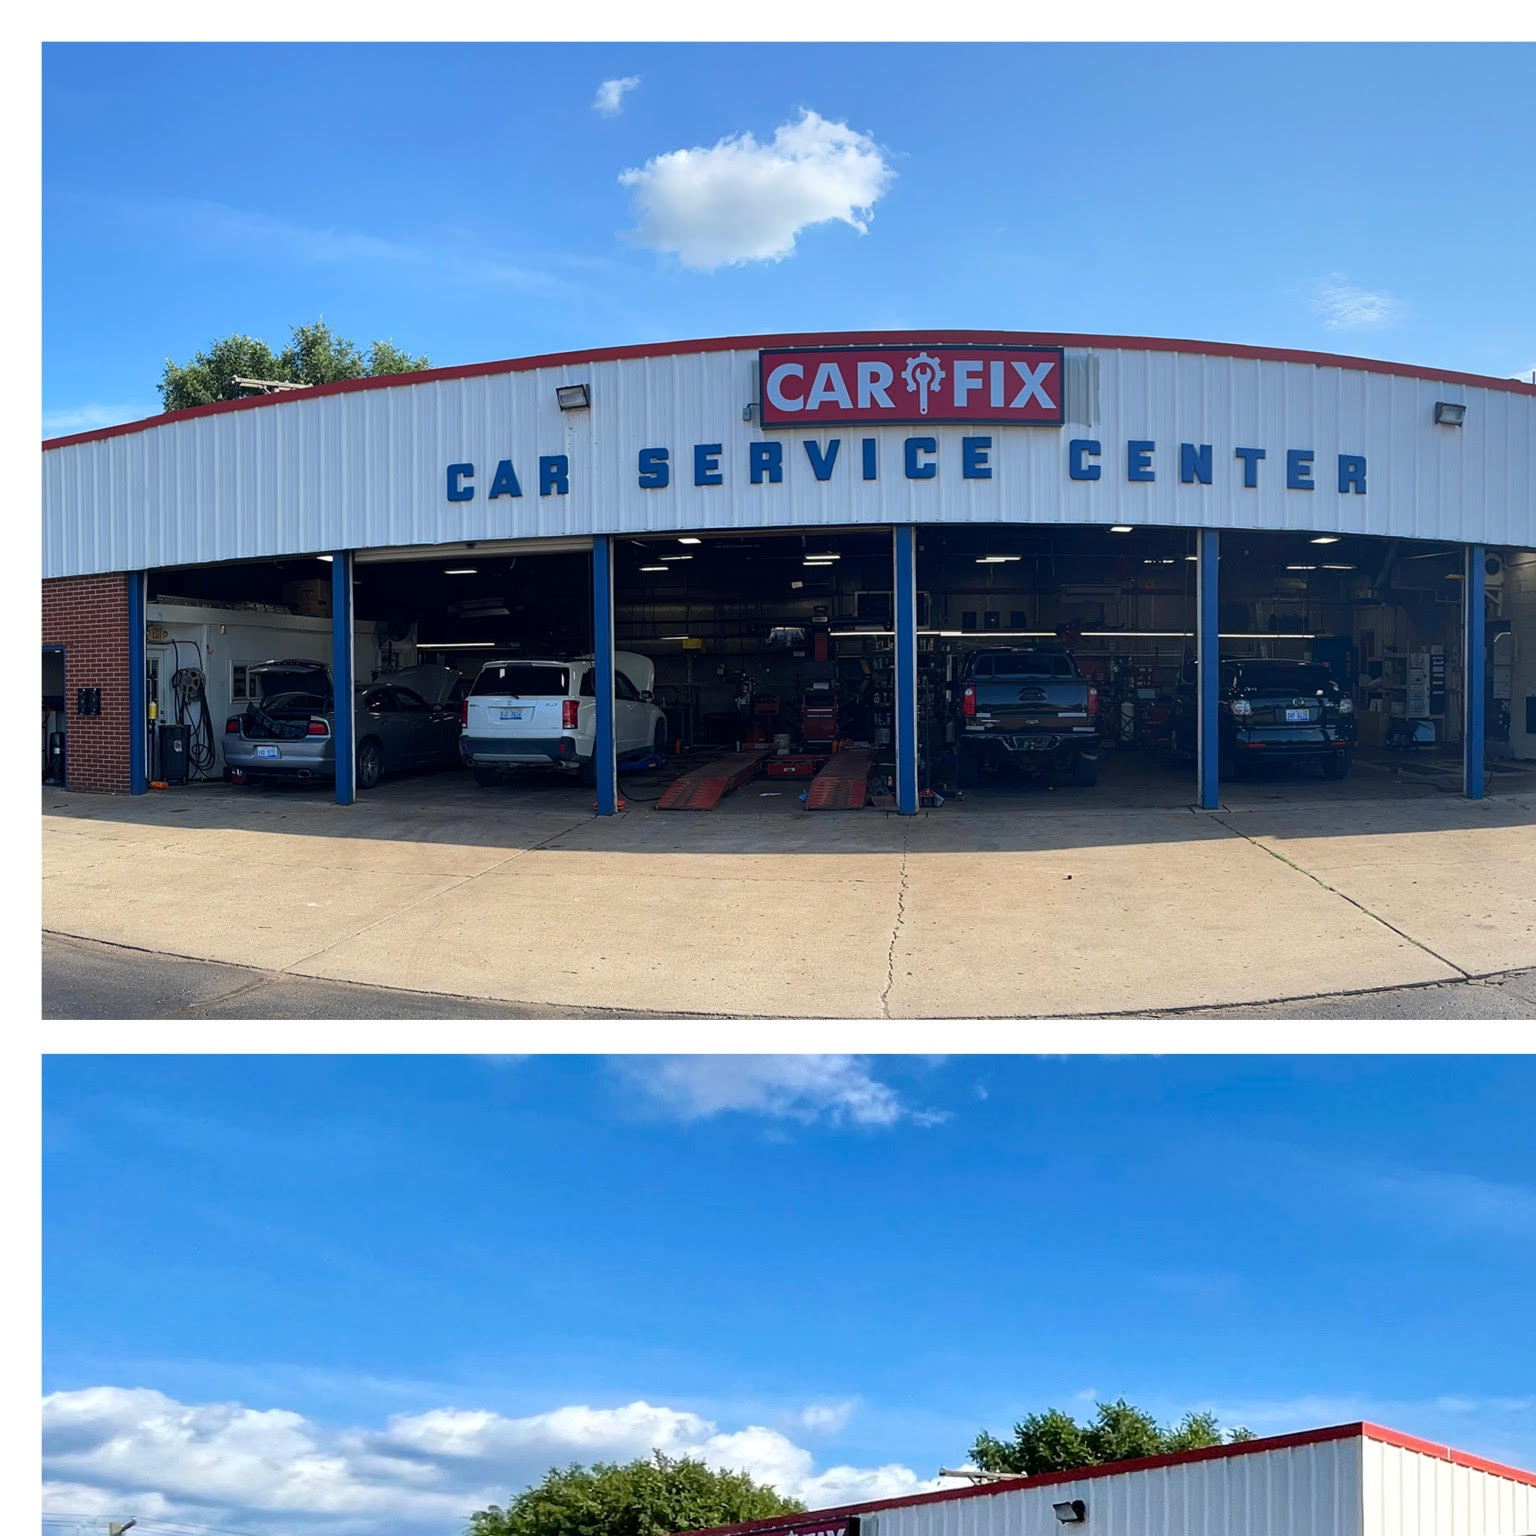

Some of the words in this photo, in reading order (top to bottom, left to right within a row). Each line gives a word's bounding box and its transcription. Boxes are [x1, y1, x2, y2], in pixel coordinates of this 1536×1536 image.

[766, 362, 896, 412] CAR
[954, 360, 1057, 409] FIX
[446, 454, 570, 503] CAR
[638, 436, 993, 490] SERVICE
[1069, 438, 1368, 494] CENTER
